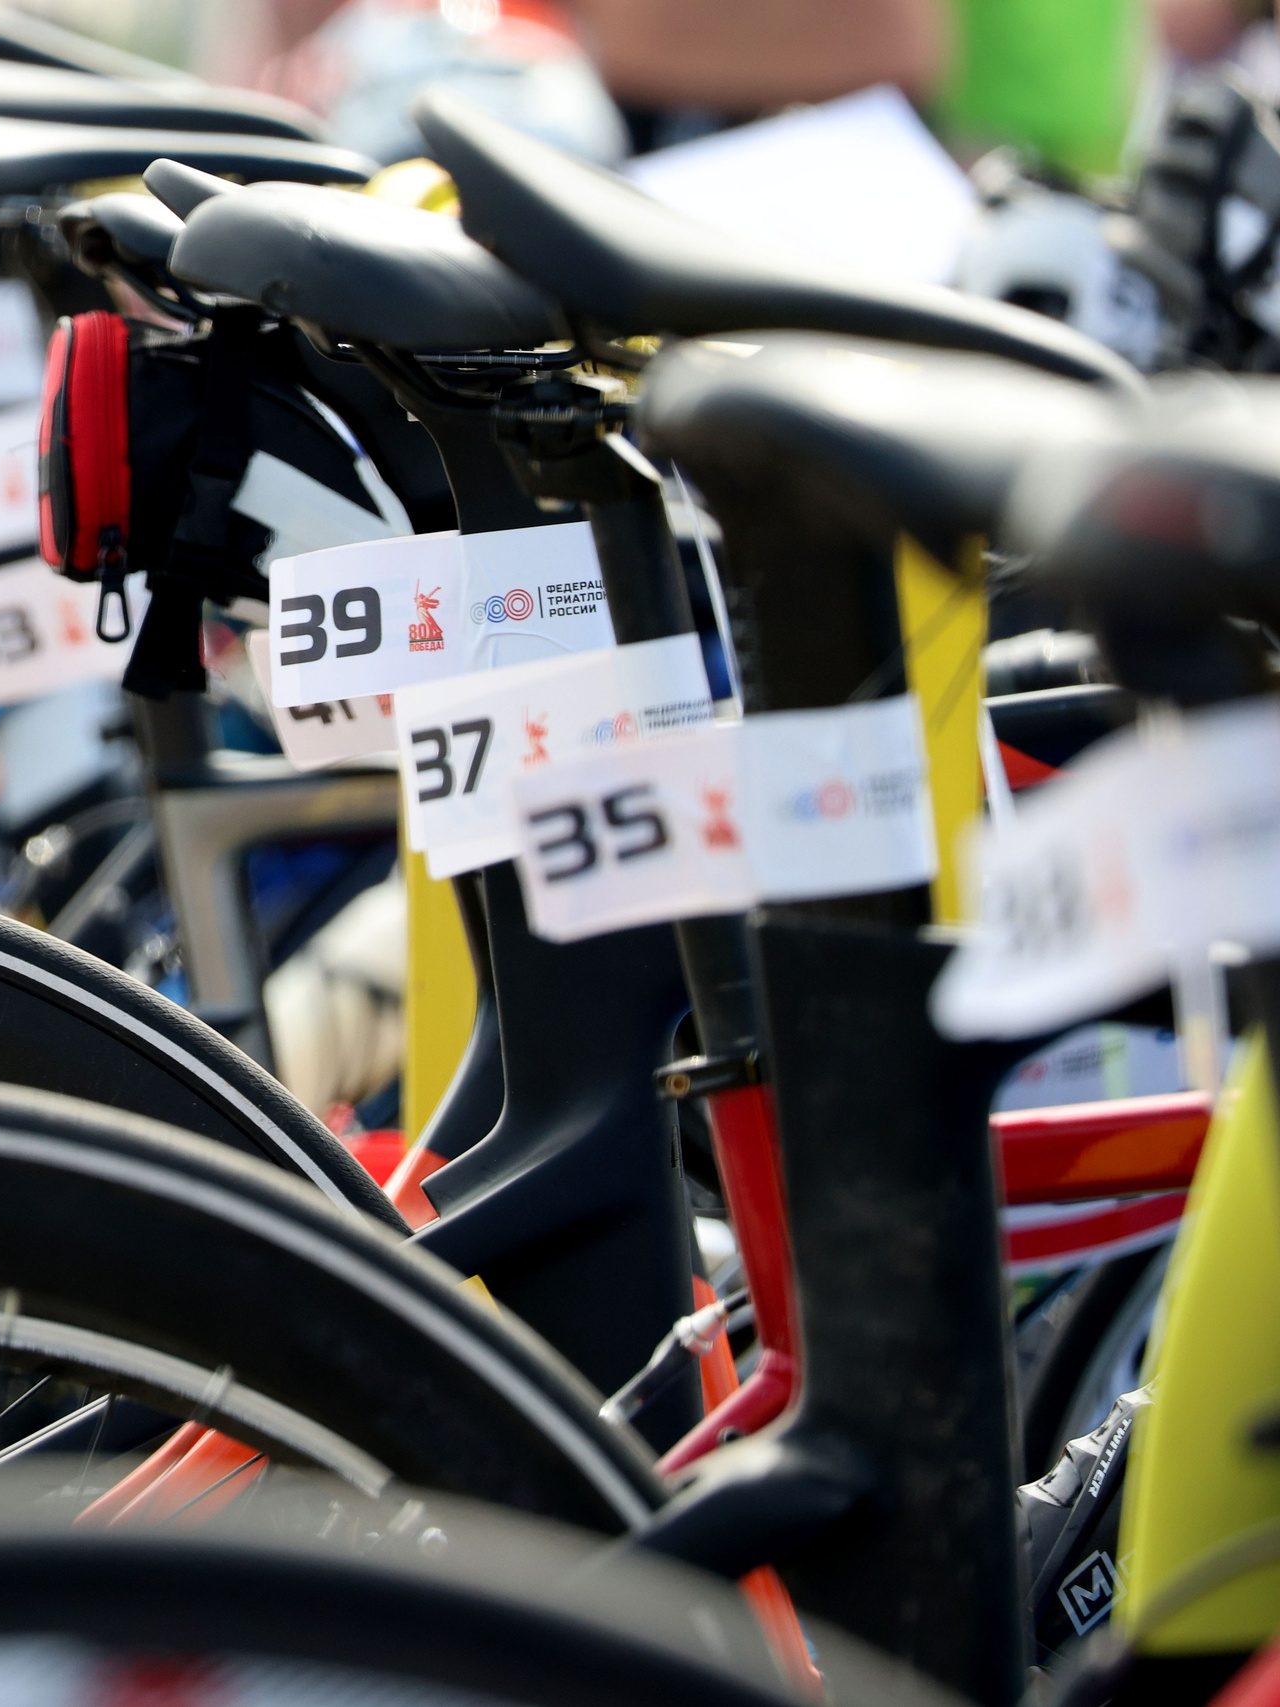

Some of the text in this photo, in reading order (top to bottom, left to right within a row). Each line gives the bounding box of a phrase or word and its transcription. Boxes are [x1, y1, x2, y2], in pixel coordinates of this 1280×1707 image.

[546, 579, 606, 594] ФЕДЕРАЦ
[549, 604, 597, 617] РОССИИ
[280, 586, 382, 666] 39
[409, 623, 427, 640] 80
[409, 641, 445, 652] ПОБЕДА!
[411, 717, 495, 802] 37
[528, 784, 668, 882] 35
[1088, 1418, 1133, 1498] TWITTER
